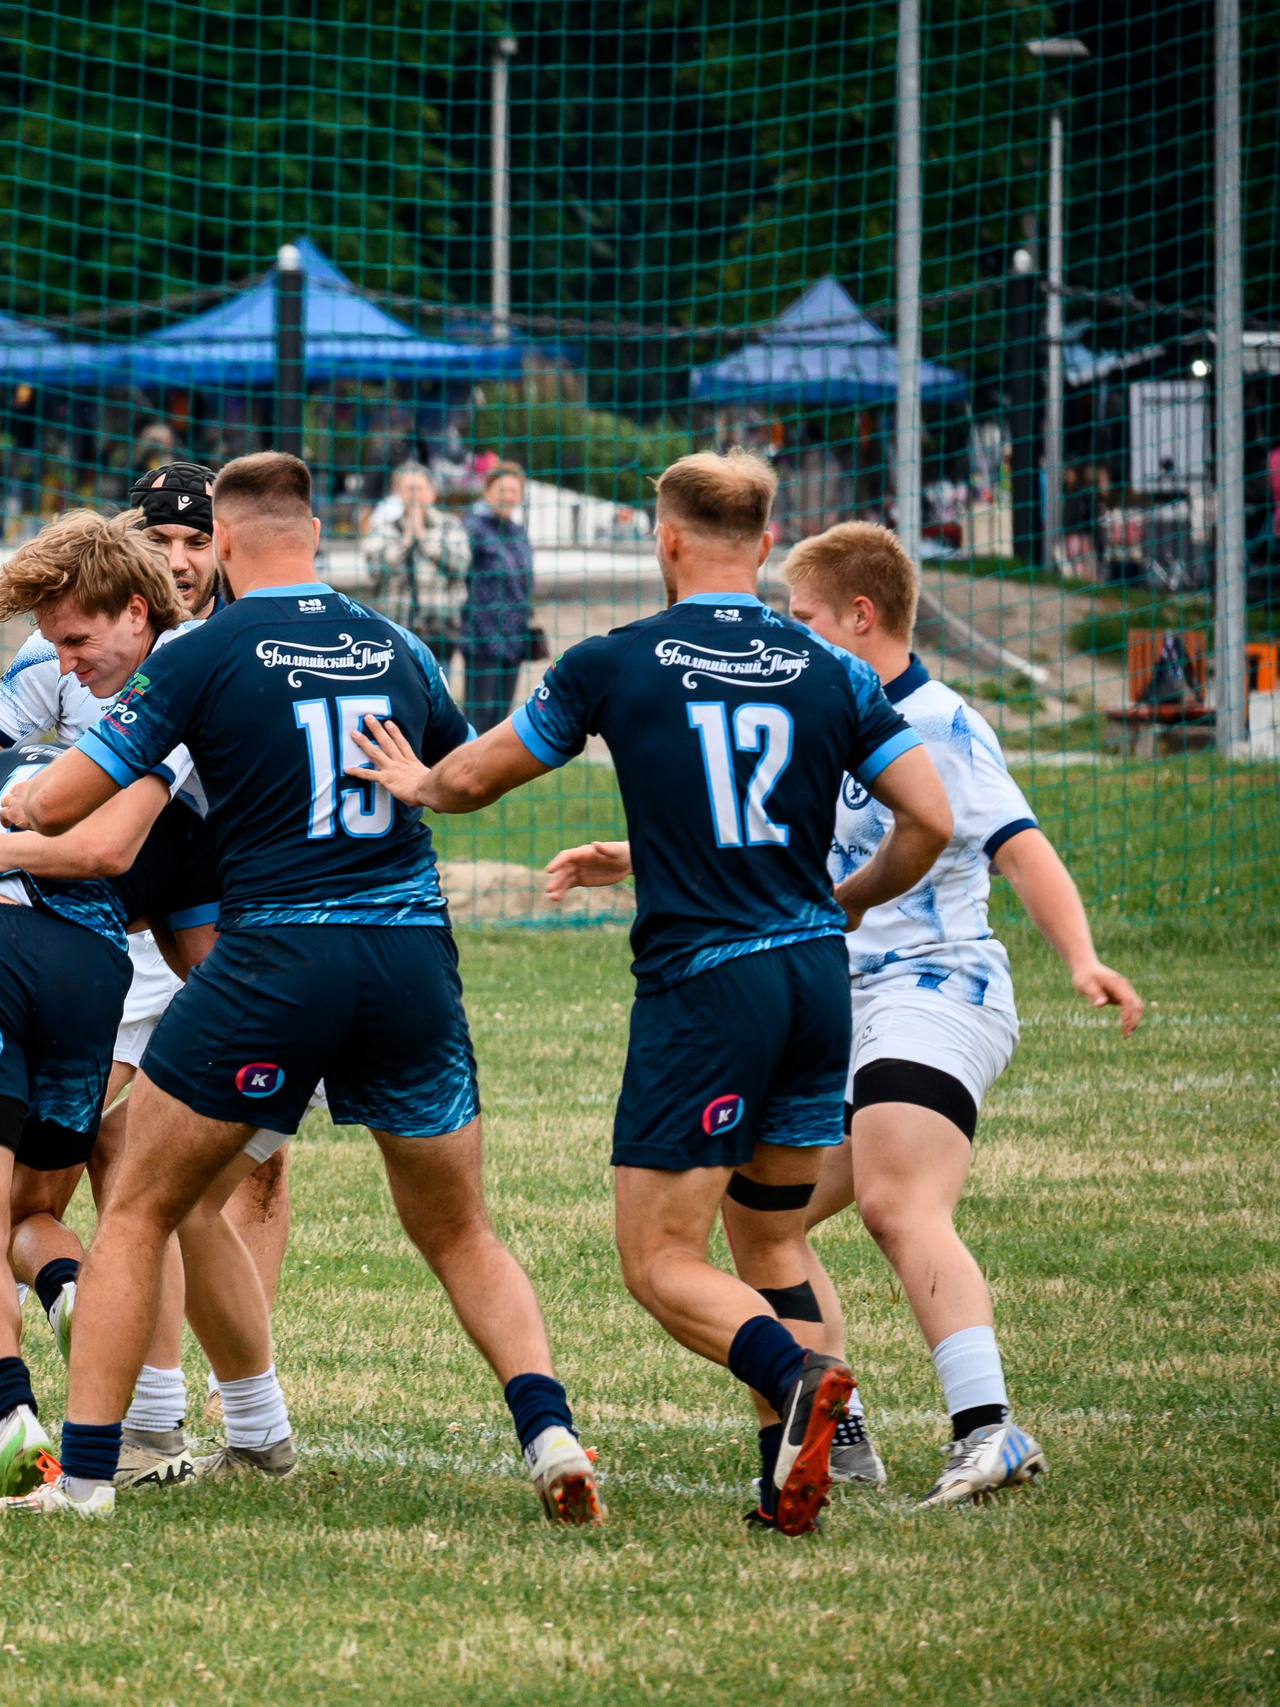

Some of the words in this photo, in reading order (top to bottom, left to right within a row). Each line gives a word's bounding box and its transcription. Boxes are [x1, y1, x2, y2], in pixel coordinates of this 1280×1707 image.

[256, 635, 355, 669] Балтийский
[352, 640, 396, 670] Парус
[655, 640, 763, 676] Балтийский
[760, 648, 811, 676] Парус
[292, 695, 395, 839] 15
[686, 701, 795, 849] 12
